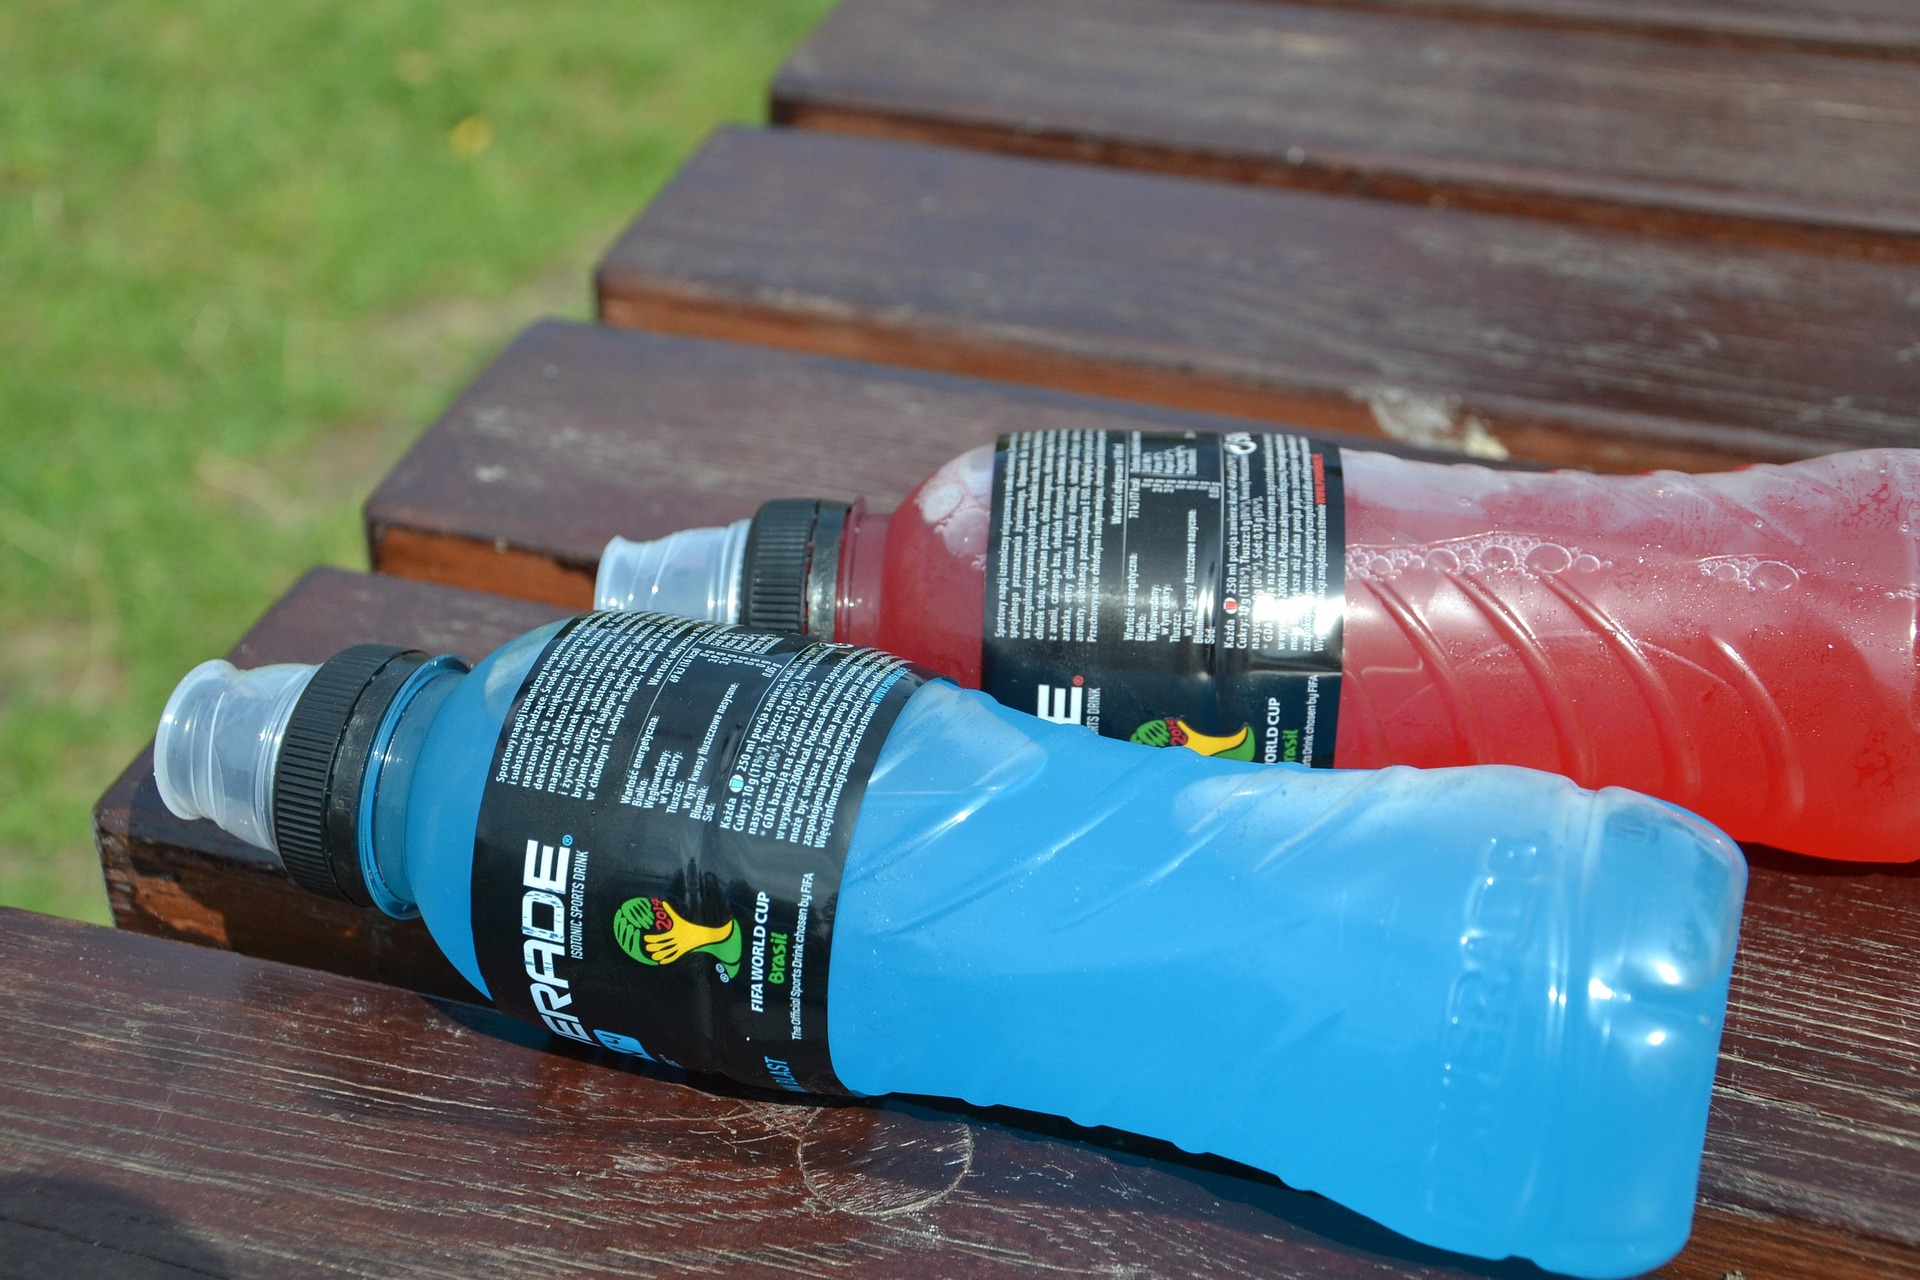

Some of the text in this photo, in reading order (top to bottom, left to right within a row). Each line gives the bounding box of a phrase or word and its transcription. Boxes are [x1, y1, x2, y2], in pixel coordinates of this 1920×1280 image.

[1265, 534, 1276, 571] średnim
[1278, 528, 1288, 558] Podczas
[1291, 534, 1303, 557] jedna
[1316, 540, 1328, 579] znajdziesz
[994, 536, 1011, 637] Sportowy napój izotoniczny
[1009, 536, 1022, 638] specjalnego przeznaczenia
[1034, 550, 1049, 639] chlorek sodu, cytrynian
[1048, 551, 1062, 633] aronii, czarnego bzu,
[1061, 546, 1075, 641] arabska, estry glicerolu
[1087, 539, 1102, 642] Przechowywać chłodnym
[1124, 553, 1138, 640] Wartość energetyczna:
[1224, 536, 1239, 648] Każda 250 ml porcja
[1267, 573, 1275, 585] na
[1277, 577, 1287, 598] 2000
[1303, 563, 1314, 595] potrzeb
[1023, 579, 1034, 639] w szczególności
[1076, 562, 1088, 641] aromaty, substancja
[1160, 610, 1171, 626] tym
[1183, 611, 1194, 627] tym
[1237, 618, 1250, 648] Cukry:
[1263, 622, 1275, 641] GDA
[622, 674, 643, 702] miejscu,
[647, 658, 672, 685] Wartość
[669, 675, 680, 683] 69
[1307, 675, 1319, 693] FIFA
[607, 705, 626, 735] suchym
[803, 682, 829, 718] dziennym
[819, 680, 845, 717] aktywności
[1087, 687, 1101, 735] RTS DRINK
[1305, 705, 1316, 734] chosen
[1306, 693, 1320, 704] by
[496, 671, 548, 782] Sportowy napój izotoniczny
[511, 668, 561, 780] substancje słodzące. Środek
[522, 673, 574, 787] narażonych na zwiększony
[533, 662, 593, 789] dekstroza, fruktoza, kwas: kwas
[548, 747, 568, 792] magnezu,
[561, 713, 580, 745] chlorek
[575, 683, 594, 712] wapnia
[589, 652, 614, 679] fosforan
[560, 671, 615, 788] żywicy roślinnej, substancje
[571, 667, 632, 798] brylantowy FCF. Najlepiej spożyć
[788, 719, 809, 756] średnim
[805, 716, 825, 746] Podczas
[1264, 697, 1280, 764] ORLD CUP
[588, 744, 609, 788] chłodnym
[620, 716, 659, 803] Wartość energetyczna:
[682, 683, 739, 808] w tym kwasy tłuszczowe nasycone:
[720, 679, 786, 828] Każda 250 ml porcja zawiera:
[783, 757, 793, 770] na
[798, 747, 812, 765] kcal.
[1282, 729, 1298, 762] rasil
[1302, 735, 1314, 754] Drink
[643, 751, 671, 808] Węglowodany:
[659, 752, 683, 803] w tym cukry:
[732, 799, 751, 831] Cukry:
[742, 785, 753, 796] 10
[761, 711, 783, 743] Tłuszcz:
[748, 705, 800, 834] nasycone: 0g Sód: 0,13
[768, 771, 791, 805] bazują
[789, 702, 848, 842] może być większe niż jedna porcja
[791, 764, 805, 786] 2000
[803, 700, 863, 845] zaspokojenia potrzeb energetycznych
[814, 700, 878, 847] Więcej informacji znajdziesz na stronie
[586, 791, 595, 800] w
[666, 781, 684, 813] Tłuszcz:
[702, 803, 715, 821] Sód:
[778, 785, 797, 829] wysokości
[762, 808, 777, 828] GDA
[776, 830, 785, 839] w
[571, 850, 588, 959] ISOTONIC SPORTS DRINK
[651, 898, 672, 930] 2014
[522, 839, 596, 1044] ERADE
[751, 891, 770, 1012] FIFA WORLD CUP
[768, 932, 788, 984] Brasil
[790, 872, 815, 1040] The Official Sports Drink chosen by FIFA
